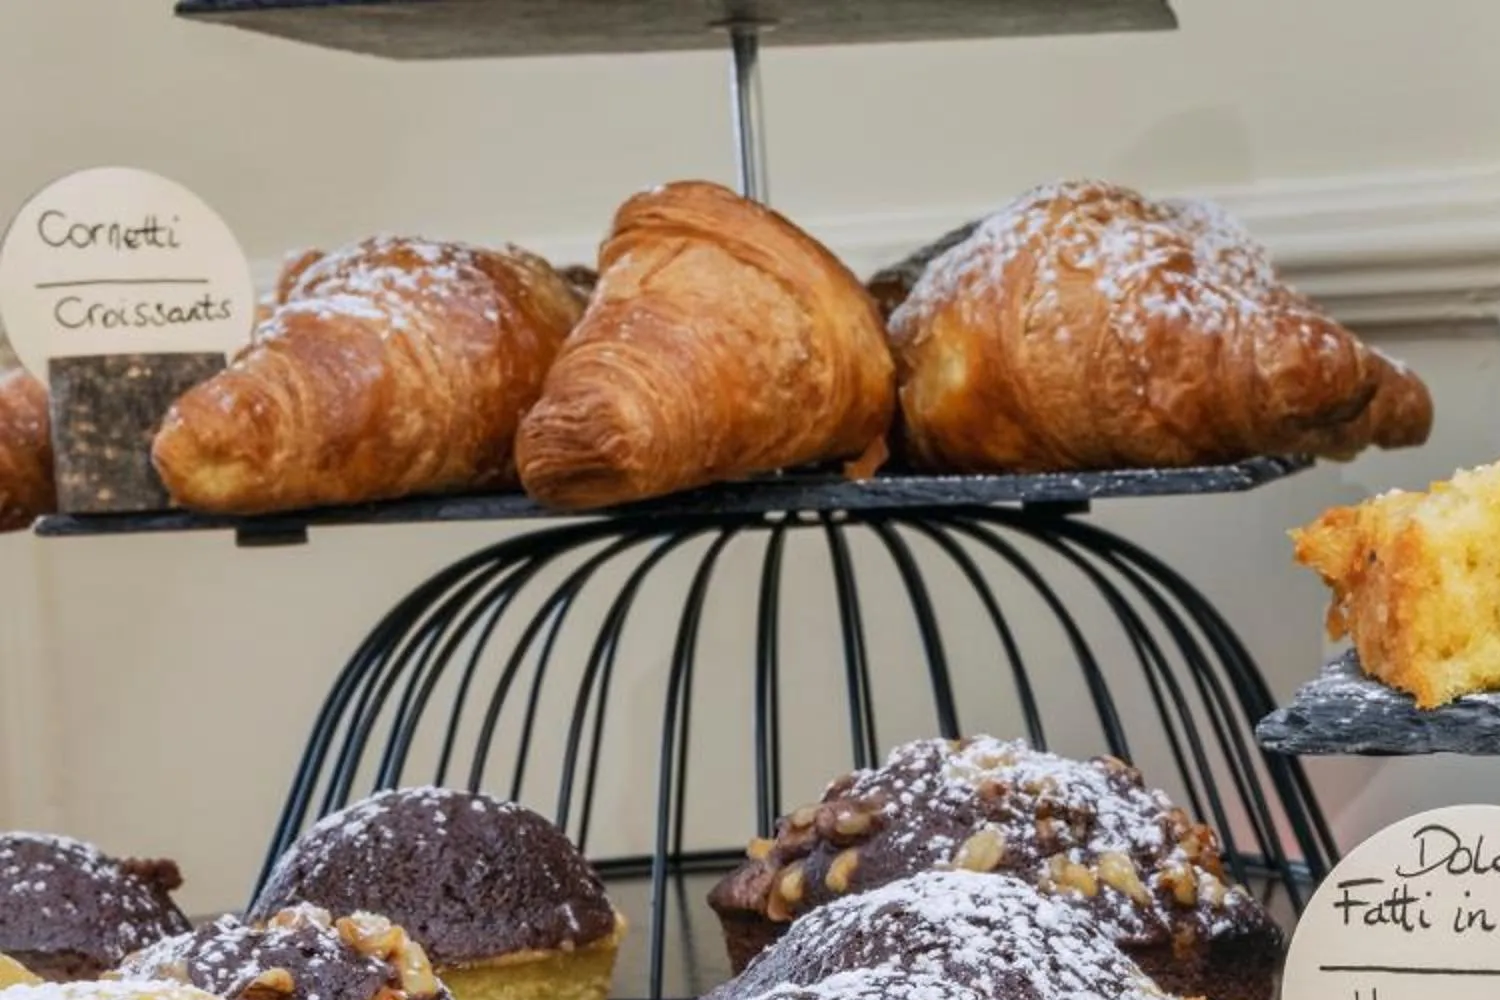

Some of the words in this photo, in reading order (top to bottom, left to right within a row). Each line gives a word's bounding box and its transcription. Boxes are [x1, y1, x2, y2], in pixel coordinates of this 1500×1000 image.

[37, 209, 182, 250] Cornetti
[1333, 877, 1433, 933] Fatti
[1453, 890, 1497, 933] in
